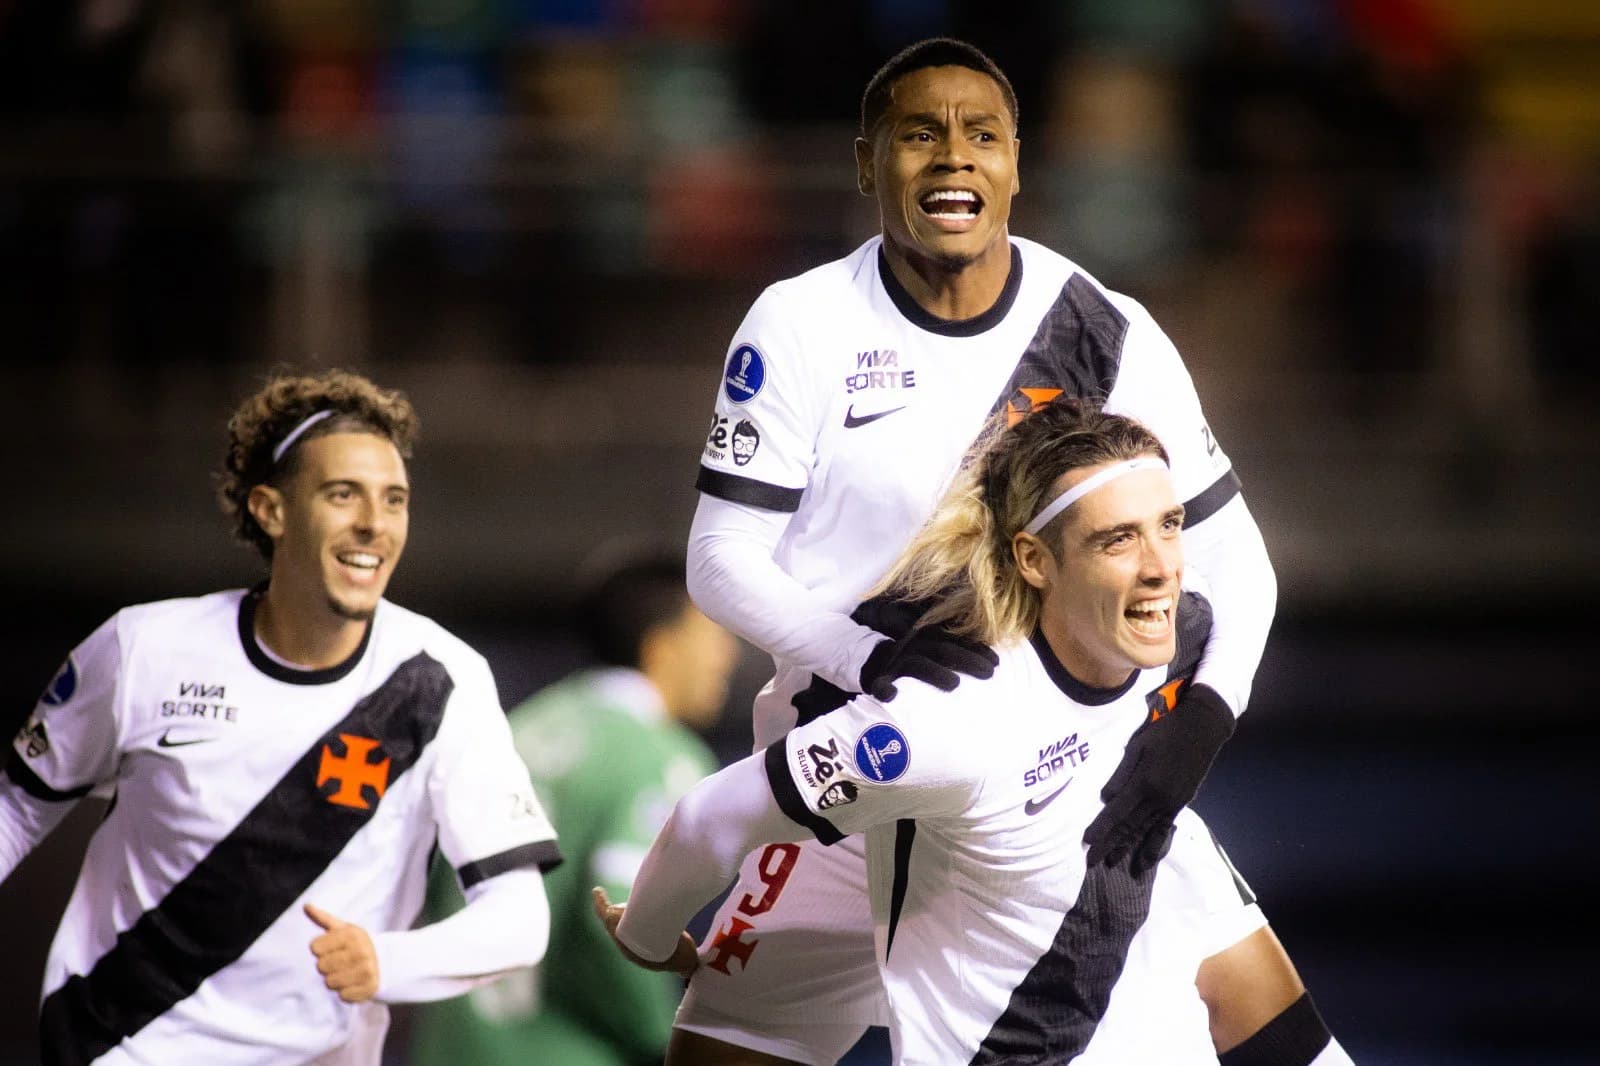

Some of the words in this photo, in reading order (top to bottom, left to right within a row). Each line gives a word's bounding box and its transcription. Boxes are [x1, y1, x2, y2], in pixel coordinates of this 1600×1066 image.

[857, 350, 898, 370] VIVA
[846, 370, 916, 394] SORTE
[180, 681, 225, 699] VIVA
[161, 701, 239, 723] SORTE
[807, 737, 844, 784] Zé
[1039, 732, 1078, 762] VIVA
[797, 748, 818, 788] DELIVERY
[1024, 742, 1090, 788] SORTE
[737, 843, 801, 917] 9
